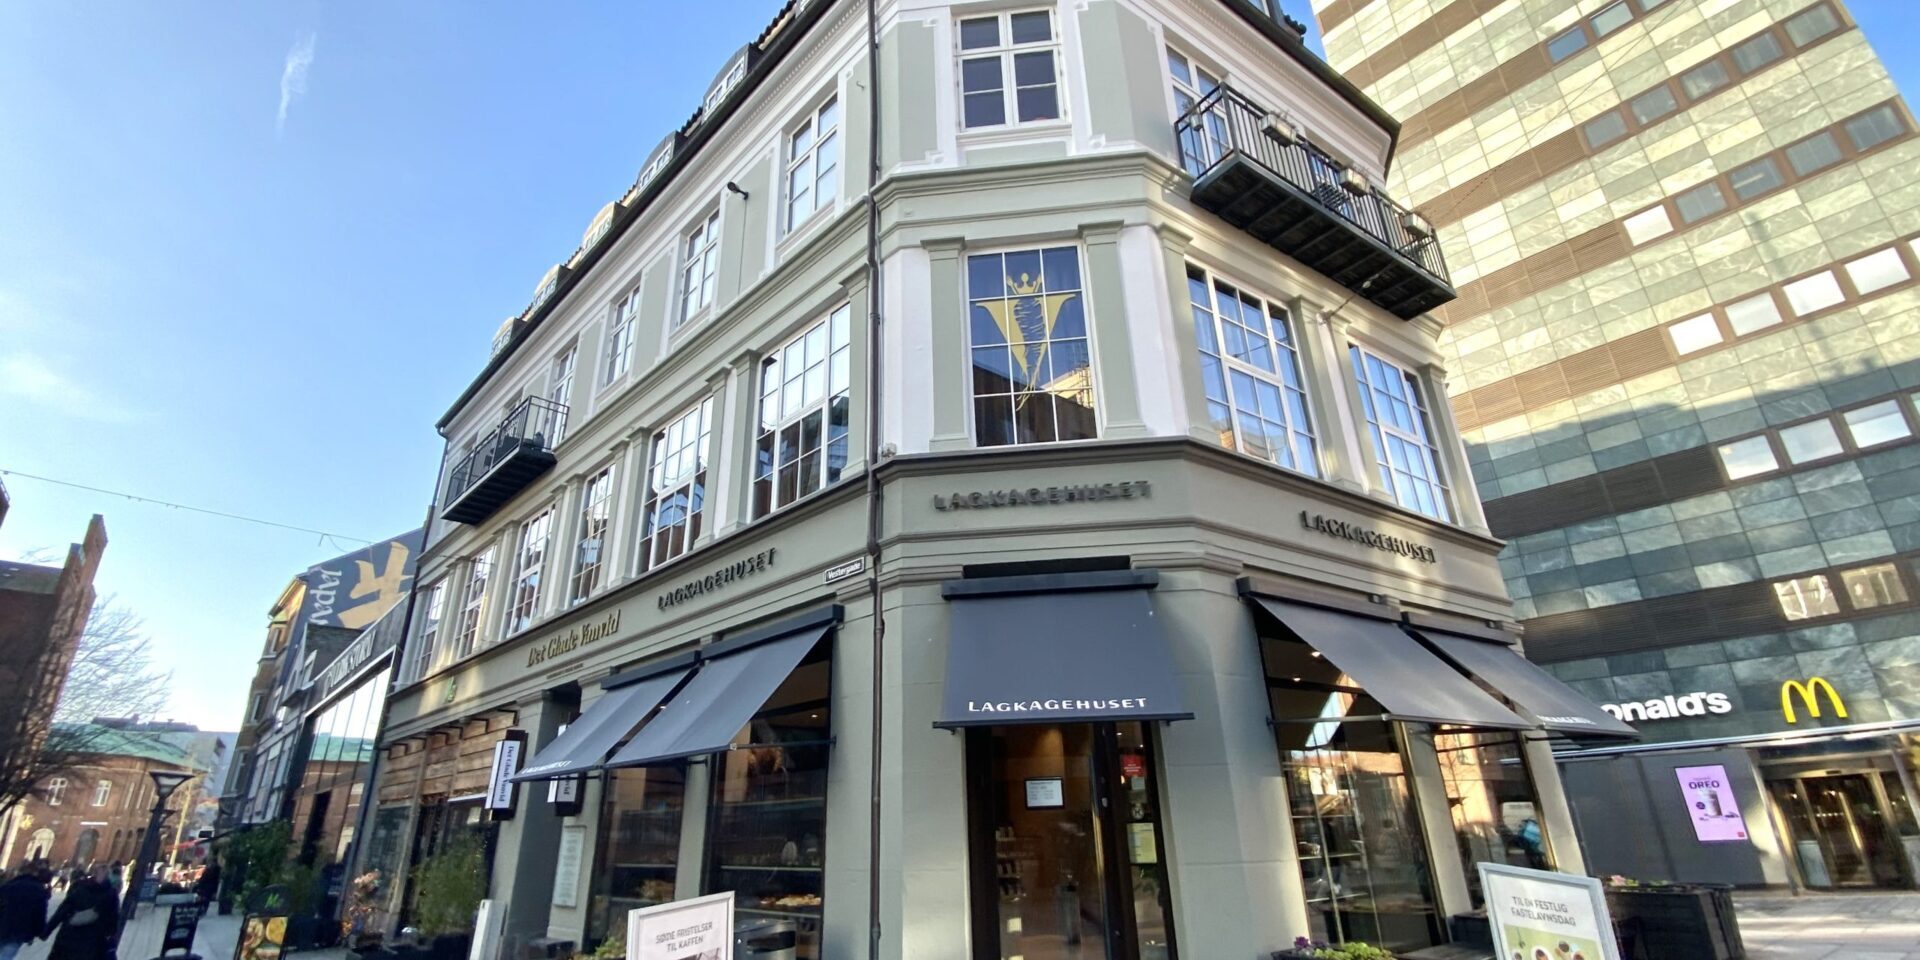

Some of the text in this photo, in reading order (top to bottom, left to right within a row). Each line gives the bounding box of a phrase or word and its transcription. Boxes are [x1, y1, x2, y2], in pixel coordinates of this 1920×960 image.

[933, 480, 1150, 511] LAGKAGEHUSET
[1300, 510, 1437, 563] LAGKAGEHUSET
[657, 548, 776, 610] LAGKAGEHUSET
[828, 562, 861, 579] Vestergade
[526, 609, 621, 668] Det Glade Vanvid
[968, 697, 1147, 712] LAGKAGEHUSET
[1600, 692, 1732, 722] onald's
[1689, 780, 1720, 789] OREO
[1511, 907, 1576, 926] FASTELAVNSDAG
[1535, 900, 1568, 913] FESTLIG
[656, 922, 713, 944] SØDE FRISTELSER
[666, 936, 703, 952] TIL KAFFEN
